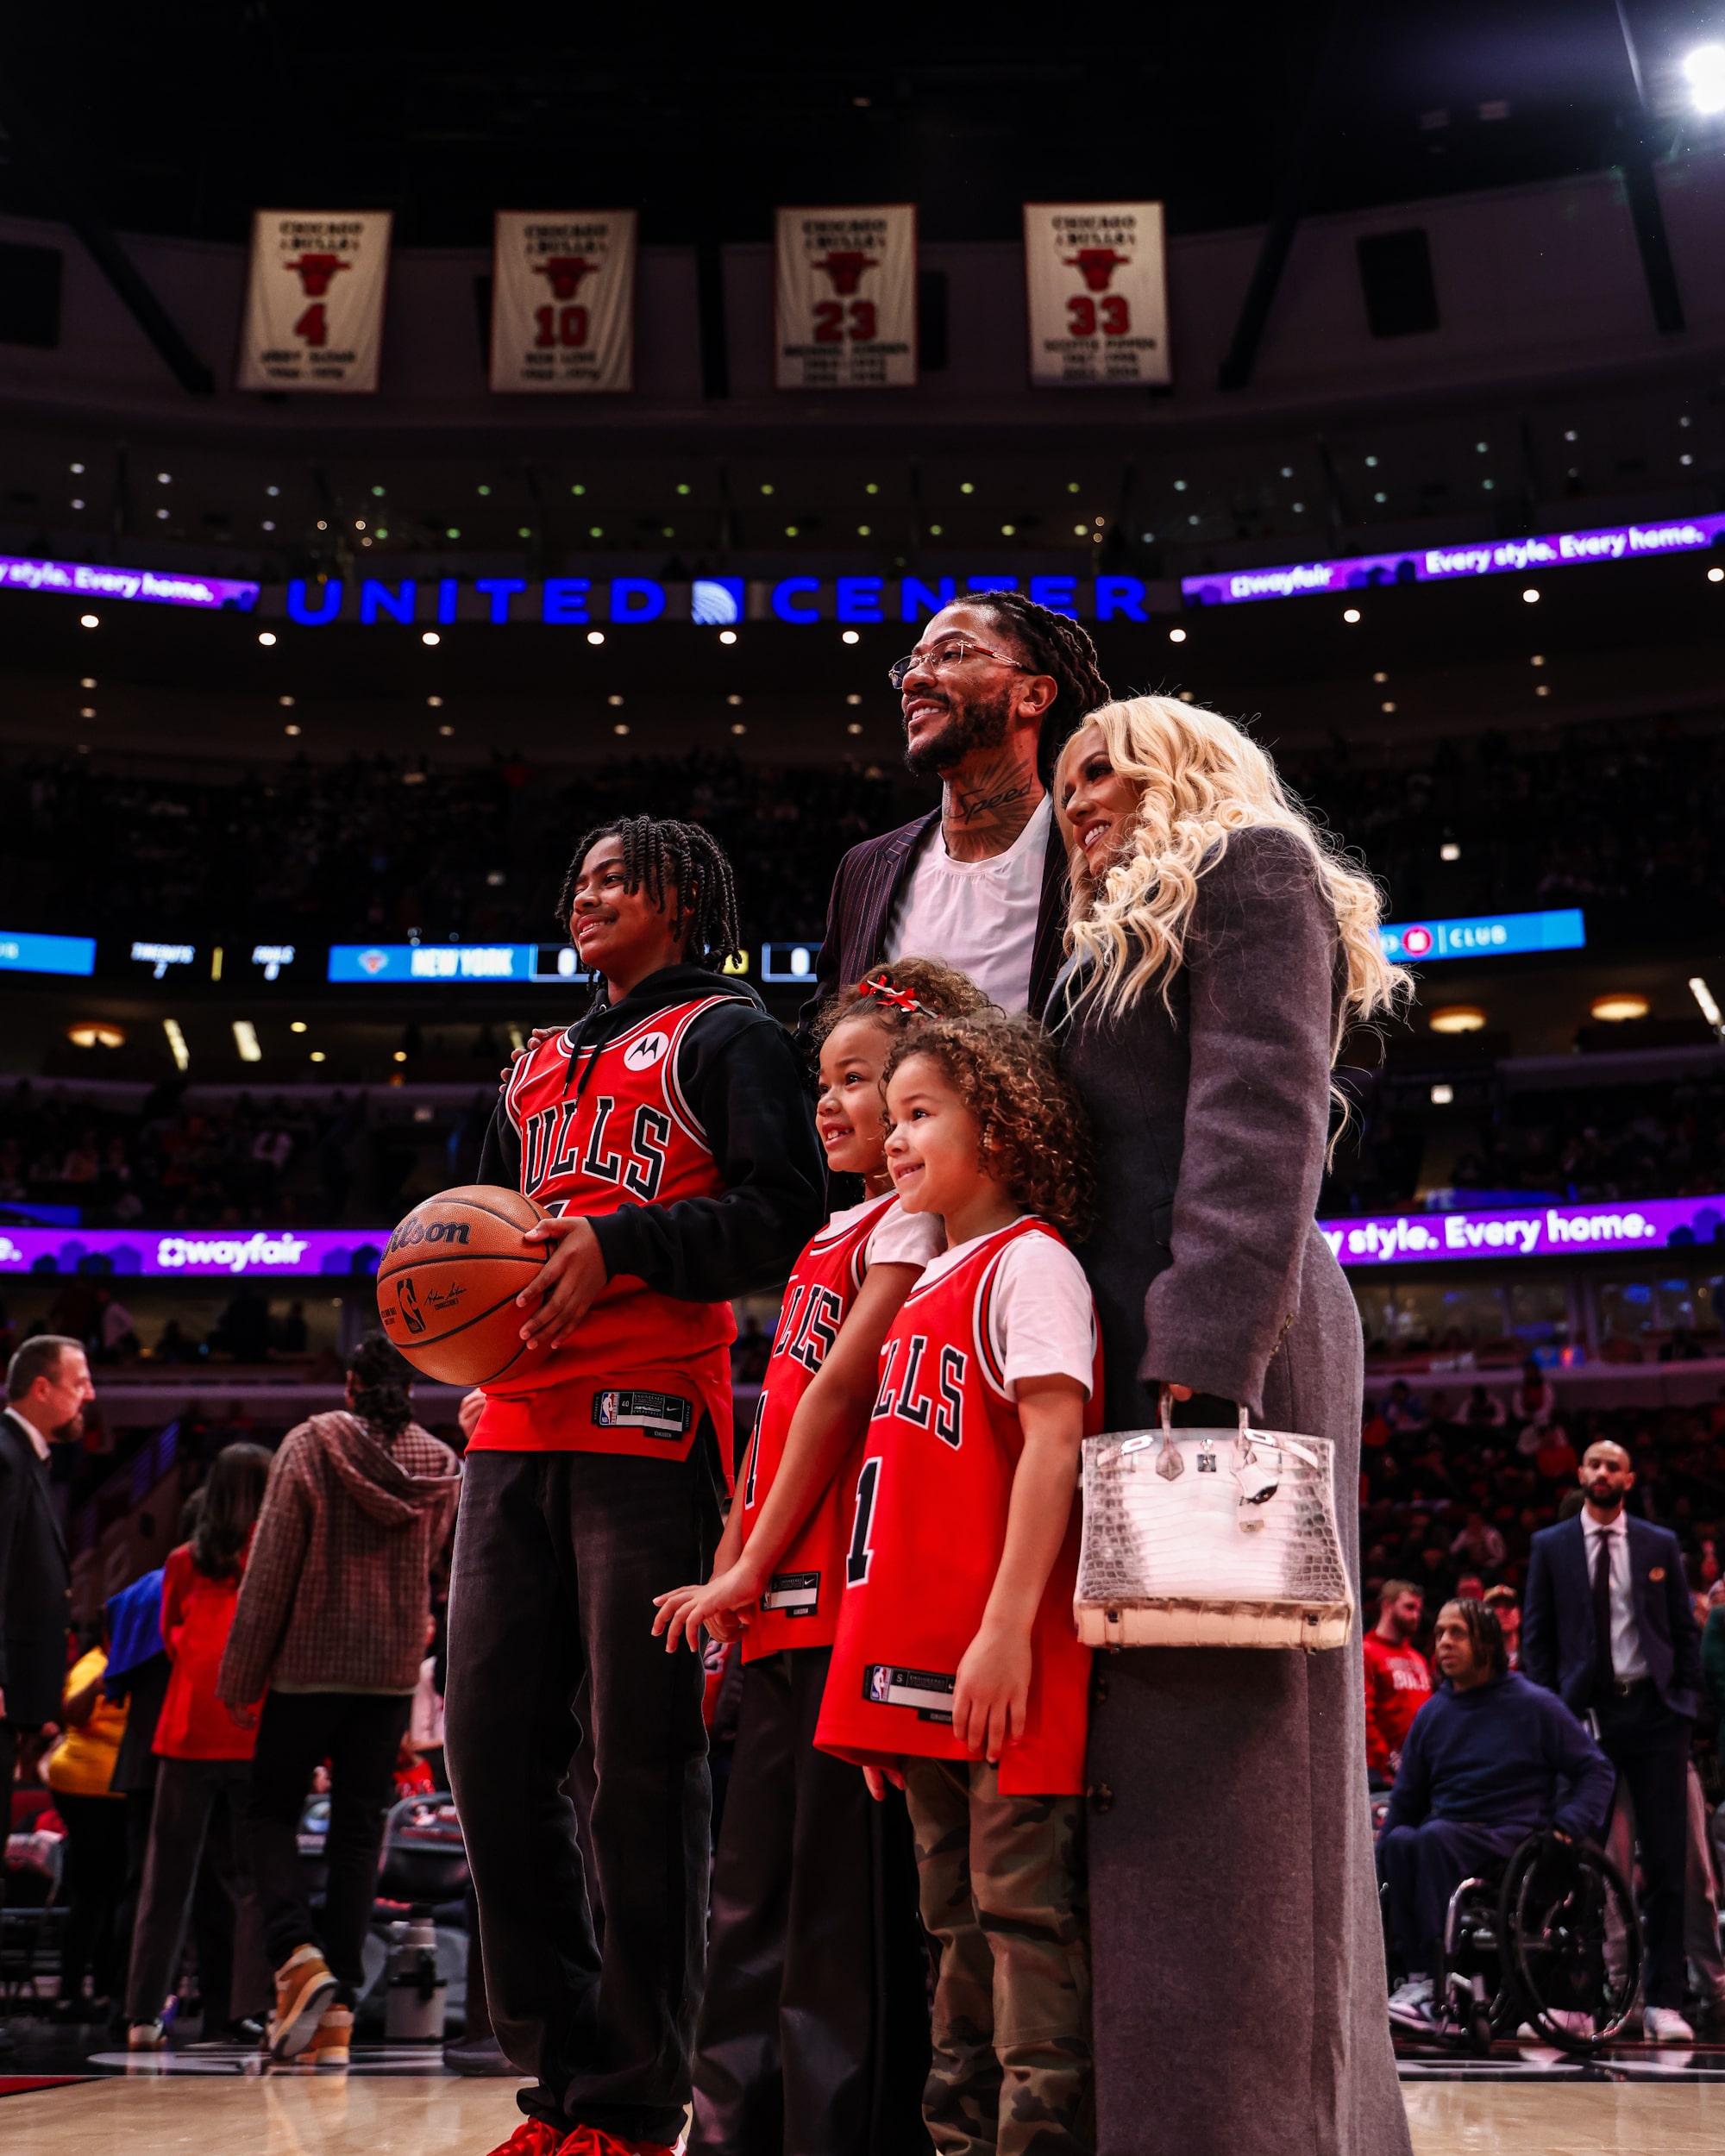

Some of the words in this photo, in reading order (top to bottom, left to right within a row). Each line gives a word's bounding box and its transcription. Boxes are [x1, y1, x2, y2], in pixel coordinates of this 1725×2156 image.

[295, 302, 327, 347] 4
[536, 305, 587, 348] 10
[814, 303, 875, 342] 23
[1068, 296, 1130, 335] 33
[1426, 550, 1492, 573] Every
[1559, 535, 1627, 558] Every
[1628, 526, 1704, 550] home.
[73, 567, 141, 599] Every
[287, 577, 666, 626] UNITED
[1450, 924, 1507, 948] CLUB
[411, 949, 460, 976] NEW
[460, 949, 513, 976] YORK
[521, 1096, 671, 1202] ULLS
[186, 1232, 309, 1272] wayfair
[1348, 1217, 1440, 1261] style.
[1445, 1215, 1542, 1253] Every
[1546, 1208, 1657, 1244] home.
[773, 1283, 844, 1376] LLS
[871, 1334, 969, 1451] LLS
[845, 1455, 883, 1589] 1
